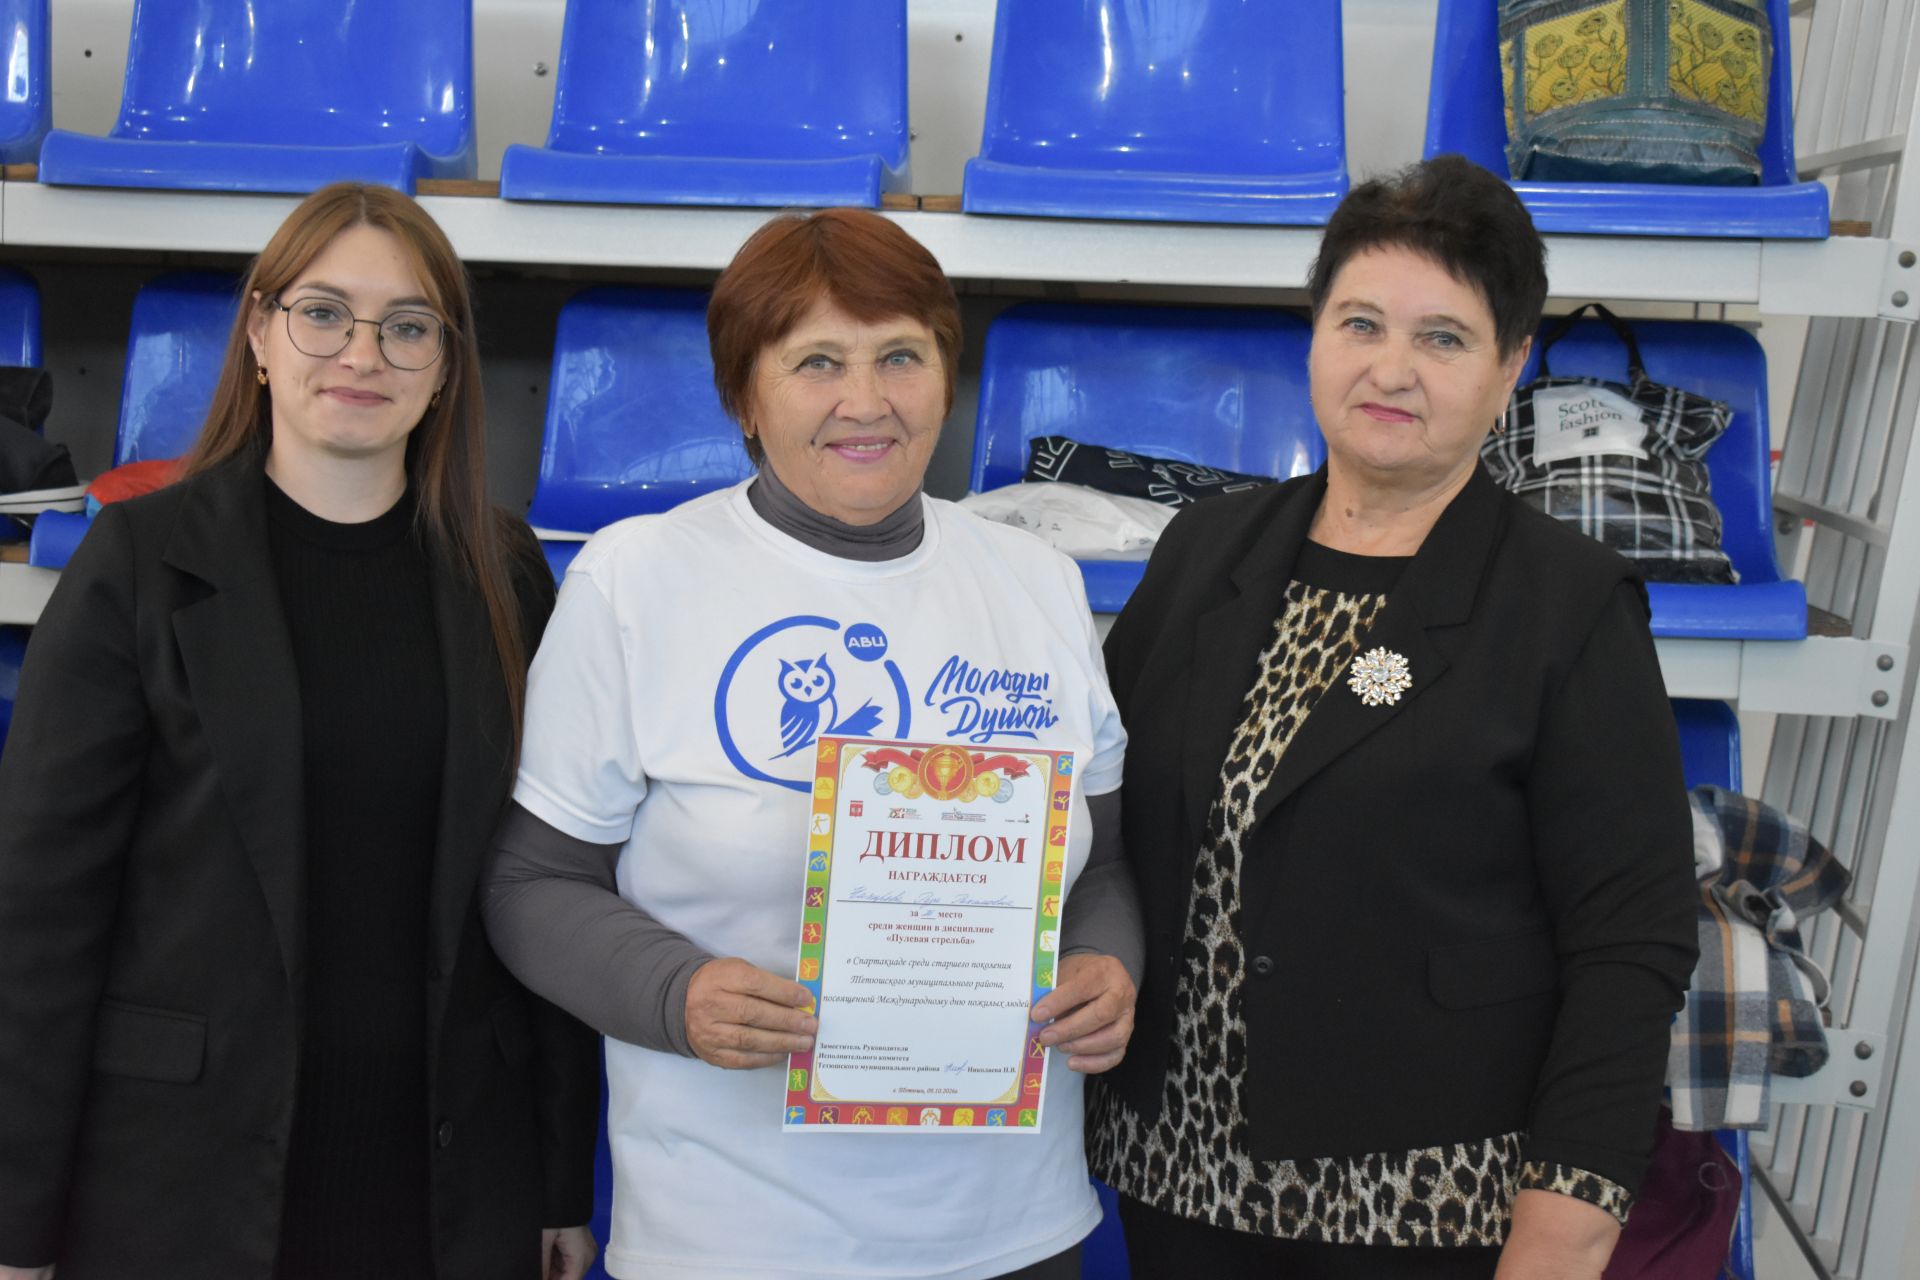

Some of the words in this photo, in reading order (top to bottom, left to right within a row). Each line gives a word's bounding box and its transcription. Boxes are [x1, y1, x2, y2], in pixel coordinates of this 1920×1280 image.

[1559, 410, 1622, 432] fashion
[848, 636, 886, 650] АВЦ
[924, 655, 1049, 707] Молоды
[940, 696, 1059, 744] Душой
[859, 830, 1028, 864] ДИПЛОМ
[888, 870, 987, 884] НАГРАЖДАЕТСЯ
[910, 910, 919, 918] за
[938, 911, 963, 919] место
[868, 923, 893, 932] среди
[895, 924, 932, 933] женщин
[942, 926, 994, 935] дисциплине
[886, 934, 929, 944] «Пулевая
[931, 936, 975, 946] стрельба»
[853, 957, 906, 968] Спартакиаде
[908, 957, 930, 969] среди
[931, 960, 970, 970] старшего
[971, 961, 1012, 971] поколения
[850, 975, 906, 987] Тетюшского
[907, 978, 974, 988] муниципального
[974, 980, 1005, 990] района,
[823, 994, 875, 1004] посвященной
[876, 995, 948, 1007] Международному
[949, 997, 966, 1006] дню
[967, 999, 1005, 1009] пожилых
[819, 1042, 861, 1050] Заместитель
[818, 1052, 877, 1061] Исполнительного
[860, 1064, 916, 1073] муниципального
[917, 1065, 940, 1073] района
